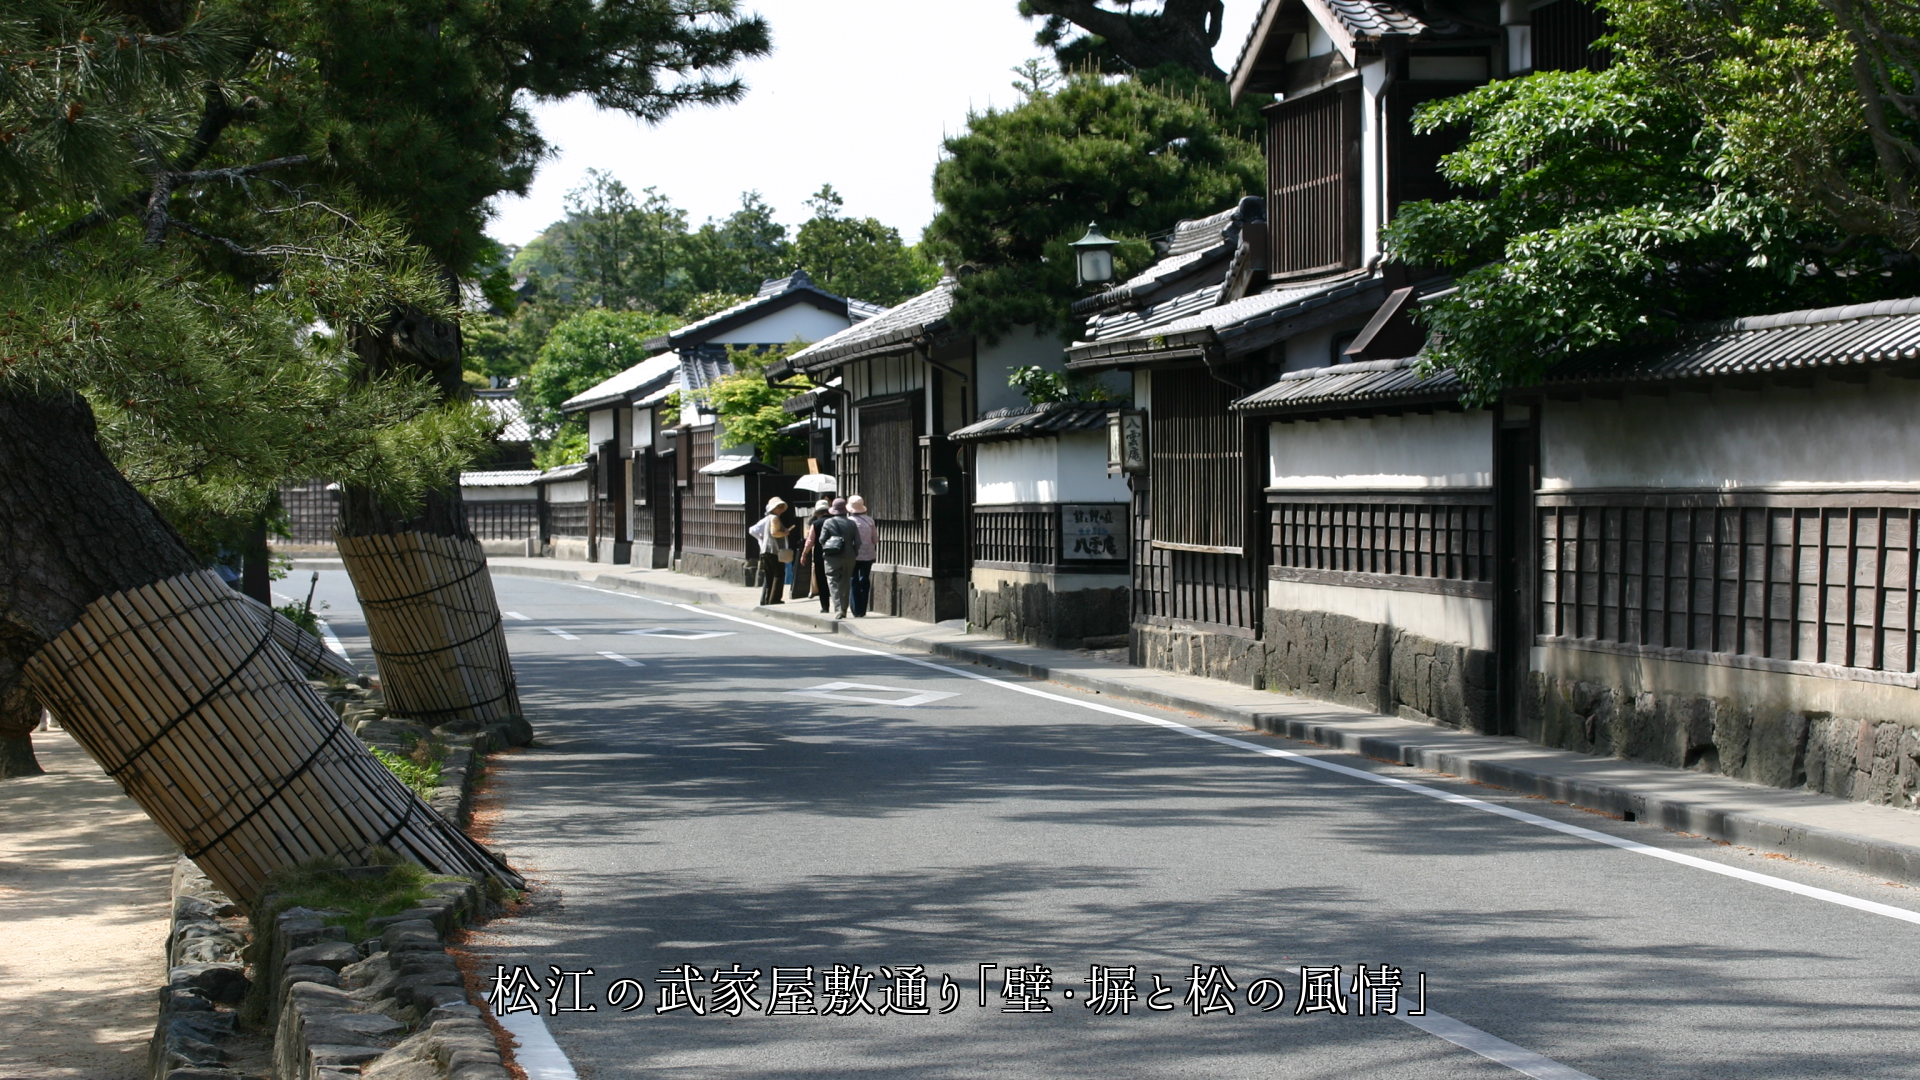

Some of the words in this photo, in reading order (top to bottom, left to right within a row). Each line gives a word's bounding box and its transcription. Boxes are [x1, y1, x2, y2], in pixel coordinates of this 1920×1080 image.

[1126, 418, 1142, 463] 八雲庵
[1073, 535, 1117, 556] 八雲庵
